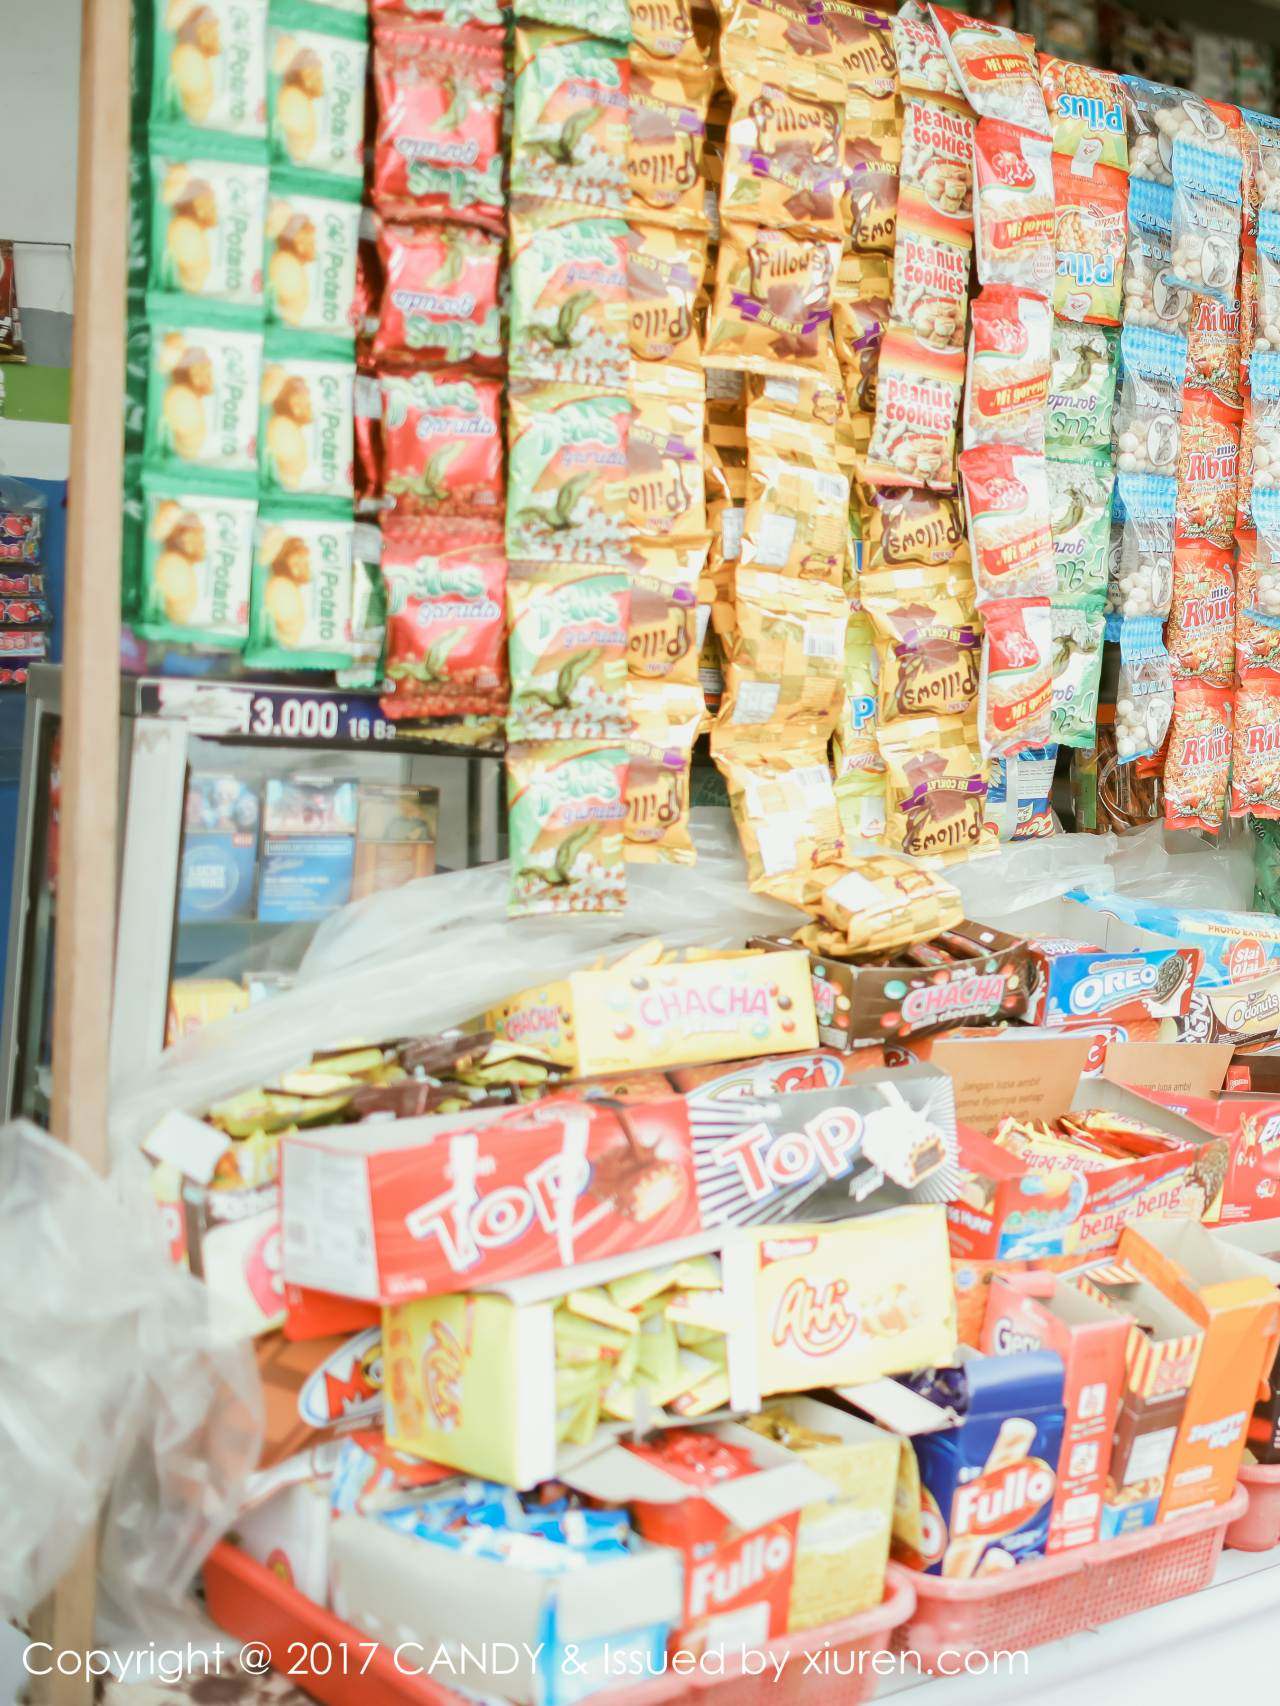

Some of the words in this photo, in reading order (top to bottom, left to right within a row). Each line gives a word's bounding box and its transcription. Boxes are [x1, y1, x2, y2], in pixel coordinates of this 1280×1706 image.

[913, 104, 972, 138] peanut
[1057, 94, 1125, 134] Pilus
[912, 128, 973, 158] cookies
[905, 242, 963, 273] peanut
[903, 263, 964, 296] cookies
[887, 378, 952, 408] peanut
[885, 402, 952, 431] cookies
[888, 517, 962, 557] Pillows
[1211, 586, 1229, 600] mie
[903, 666, 979, 705] Pillows
[911, 817, 982, 852] Pillows
[1208, 924, 1241, 936] PROMO
[638, 984, 771, 1027] CHACHA
[903, 976, 1005, 1021] CHACHA
[1074, 965, 1158, 1009] OREO
[708, 1106, 864, 1202] TOP
[1079, 1187, 1181, 1240] beng-beng
[954, 1466, 1054, 1535] Fullo
[689, 1535, 792, 1617] Fullo
